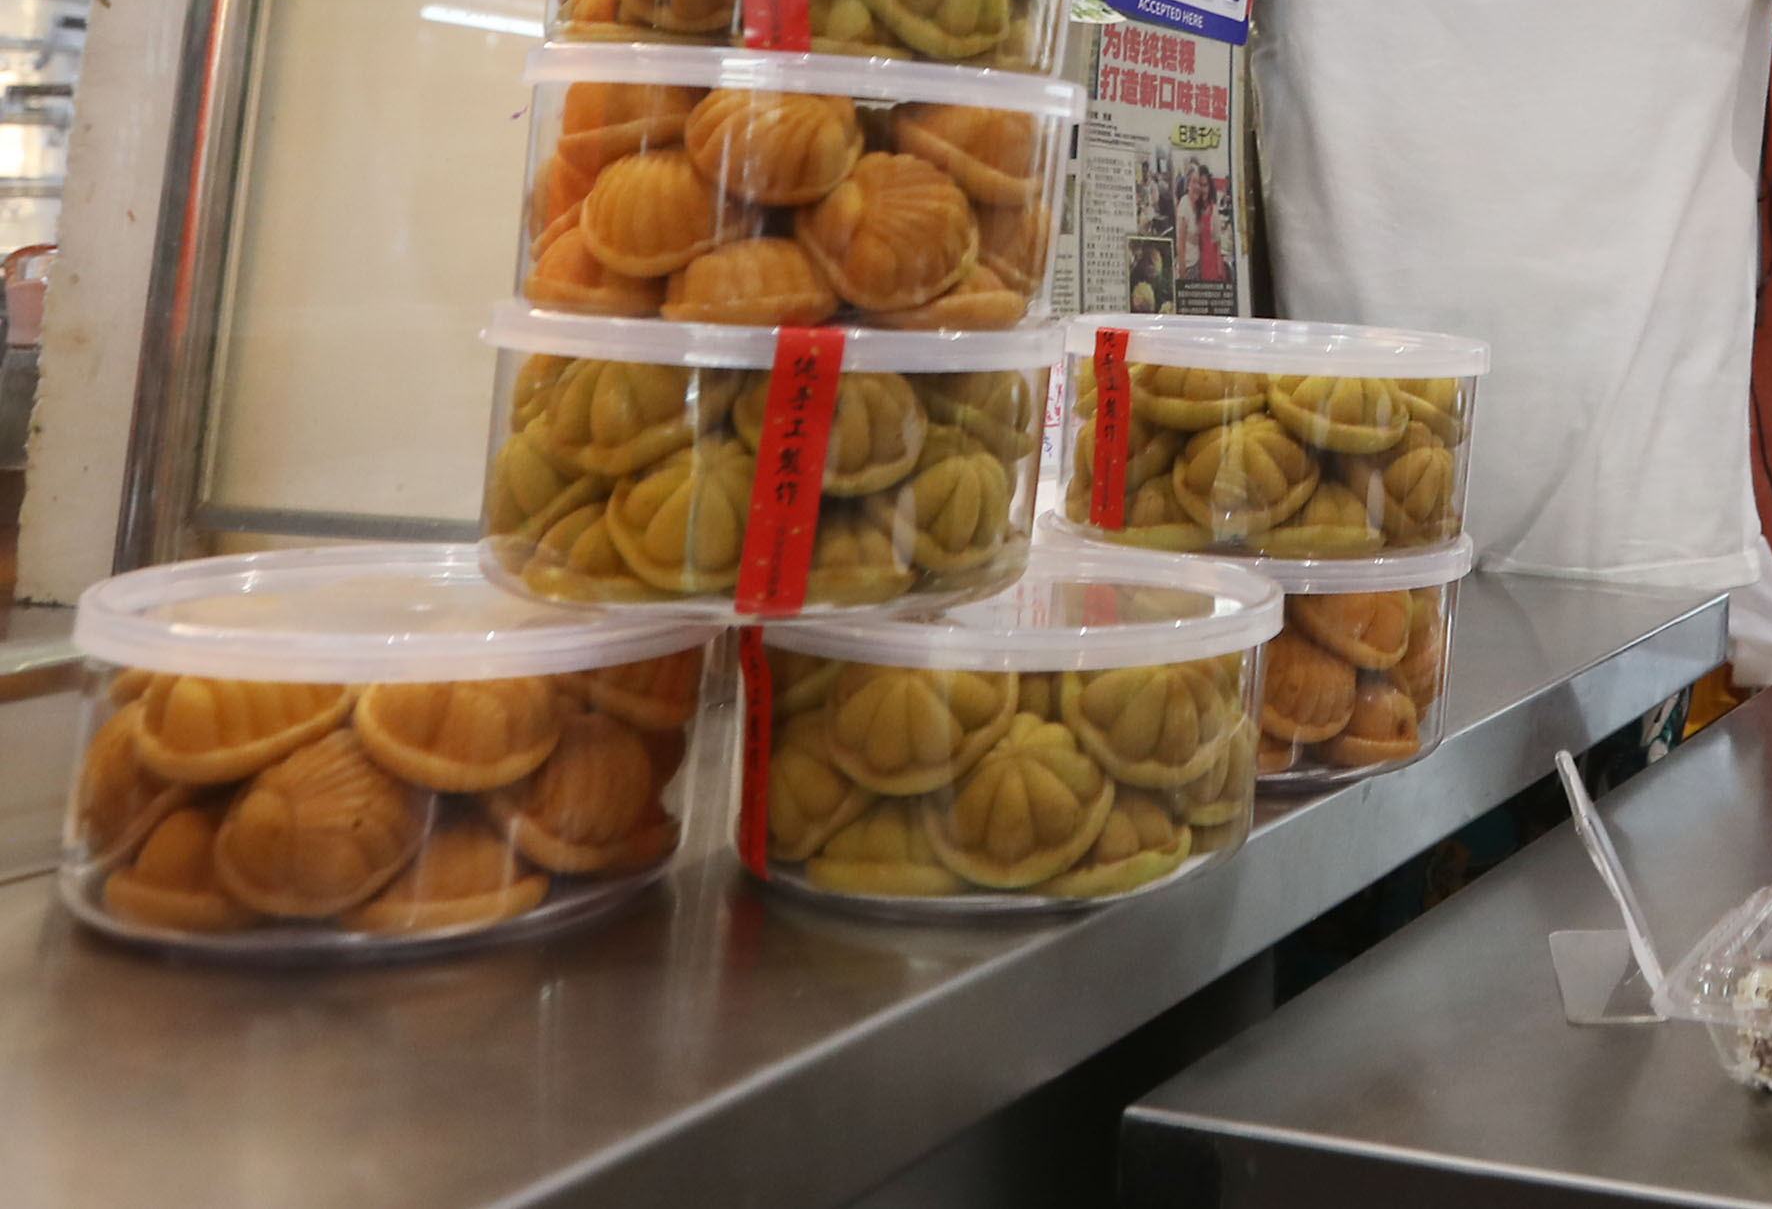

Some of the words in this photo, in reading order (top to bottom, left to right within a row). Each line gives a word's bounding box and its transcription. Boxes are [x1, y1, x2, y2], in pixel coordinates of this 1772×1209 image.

[1182, 10, 1204, 29] HERE
[1100, 63, 1228, 122] 打造新口味造型
